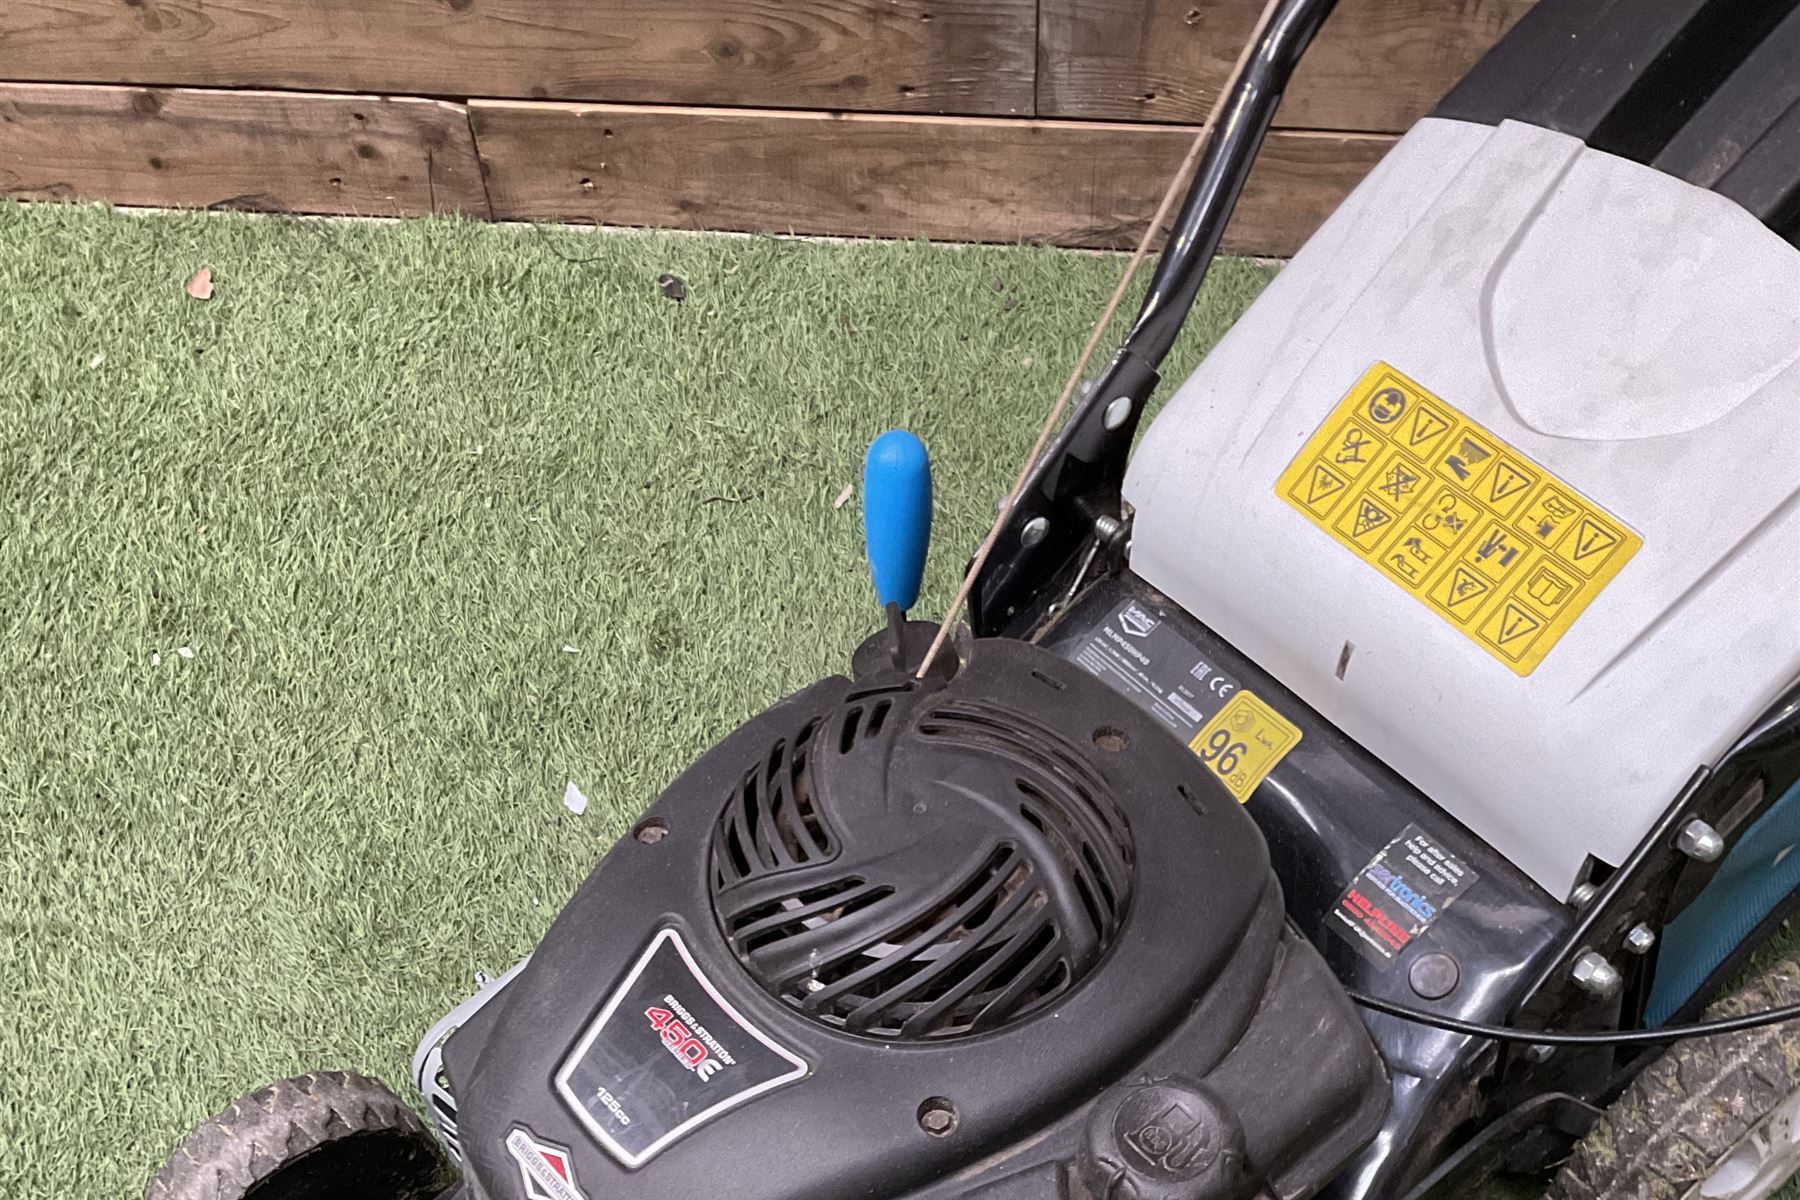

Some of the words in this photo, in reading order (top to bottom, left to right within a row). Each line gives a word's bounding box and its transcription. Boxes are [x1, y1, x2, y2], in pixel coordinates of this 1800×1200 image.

[1210, 677, 1234, 698] CE
[1200, 729, 1248, 776] 96
[1229, 773, 1248, 788] dB
[1404, 839, 1422, 855] help
[1419, 853, 1436, 866] and
[1415, 835, 1429, 847] For
[1427, 846, 1446, 861] after
[1443, 859, 1464, 877] sales
[1405, 854, 1431, 875] please
[1429, 873, 1446, 885] call
[596, 1086, 631, 1126] 125cc
